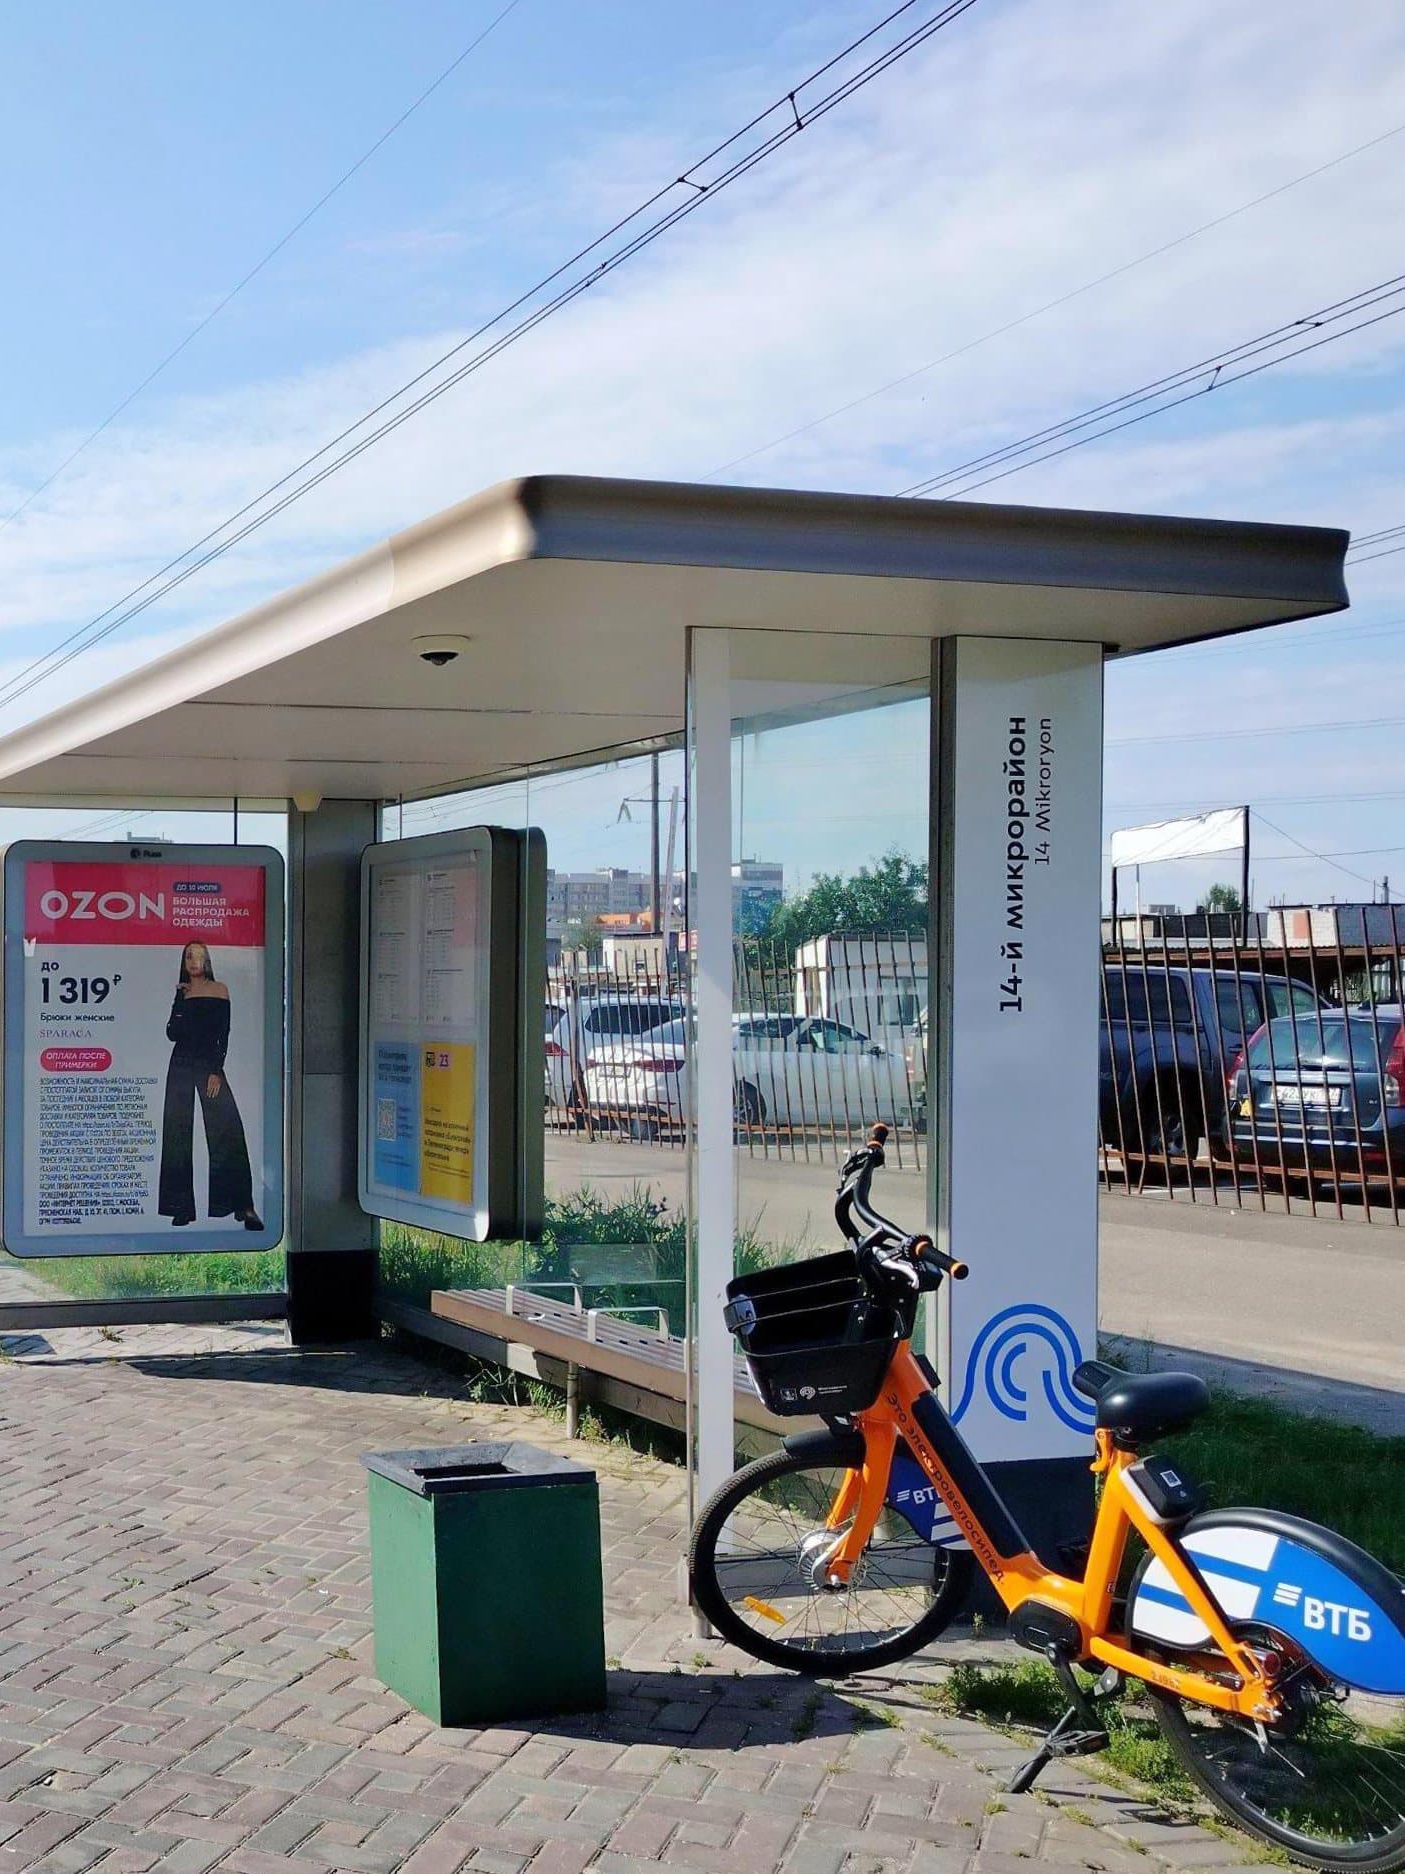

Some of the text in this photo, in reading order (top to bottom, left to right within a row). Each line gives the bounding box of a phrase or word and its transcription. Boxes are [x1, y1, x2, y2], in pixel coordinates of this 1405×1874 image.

[1034, 717, 1055, 865] 14 Mikroryon
[1000, 716, 1030, 1012] 14-й микрорайон
[40, 889, 165, 921] OZON
[172, 896, 227, 906] БОЛЬШАЯ
[172, 907, 250, 918] РАСПРОДАЖА
[172, 918, 223, 927] ОДЕЖДЫ
[41, 961, 60, 973] до
[40, 1012, 115, 1023] Брюки женские
[887, 1393, 908, 1424] Это
[913, 1486, 941, 1505] ВТ
[1303, 1595, 1372, 1642] ВТБ
